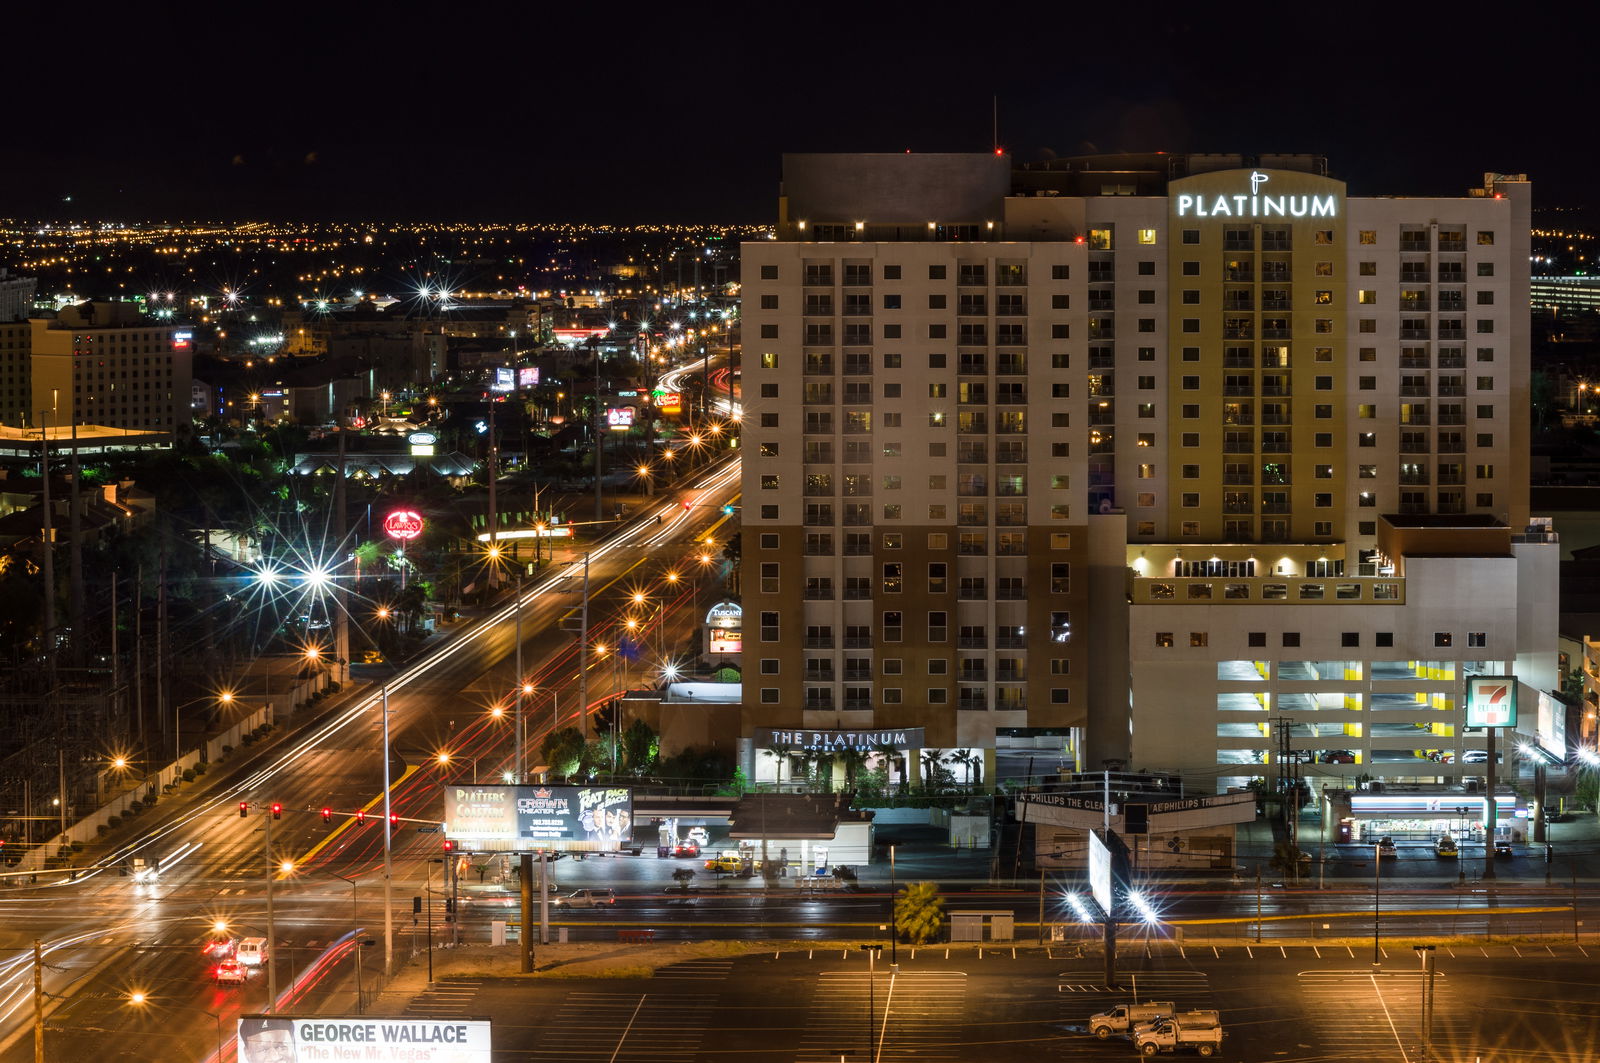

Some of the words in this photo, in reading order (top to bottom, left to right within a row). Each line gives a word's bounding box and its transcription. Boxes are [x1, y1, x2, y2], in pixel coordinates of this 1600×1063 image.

[1179, 195, 1335, 216] PLATINUM
[771, 731, 802, 744] THE
[813, 733, 907, 746] PLATINUM
[578, 789, 591, 799] THE
[580, 791, 604, 813] RAT
[605, 789, 629, 799] PACK
[517, 798, 568, 808] CROWN
[1031, 796, 1065, 806] PHILLIPS
[1067, 798, 1082, 808] THE
[1084, 800, 1106, 810] CLEA
[1164, 799, 1199, 811] PHILLIPS
[300, 1023, 376, 1042] GEORGE
[382, 1025, 467, 1043] WALLACE
[333, 1046, 361, 1060] New
[365, 1046, 387, 1060] Mr.
